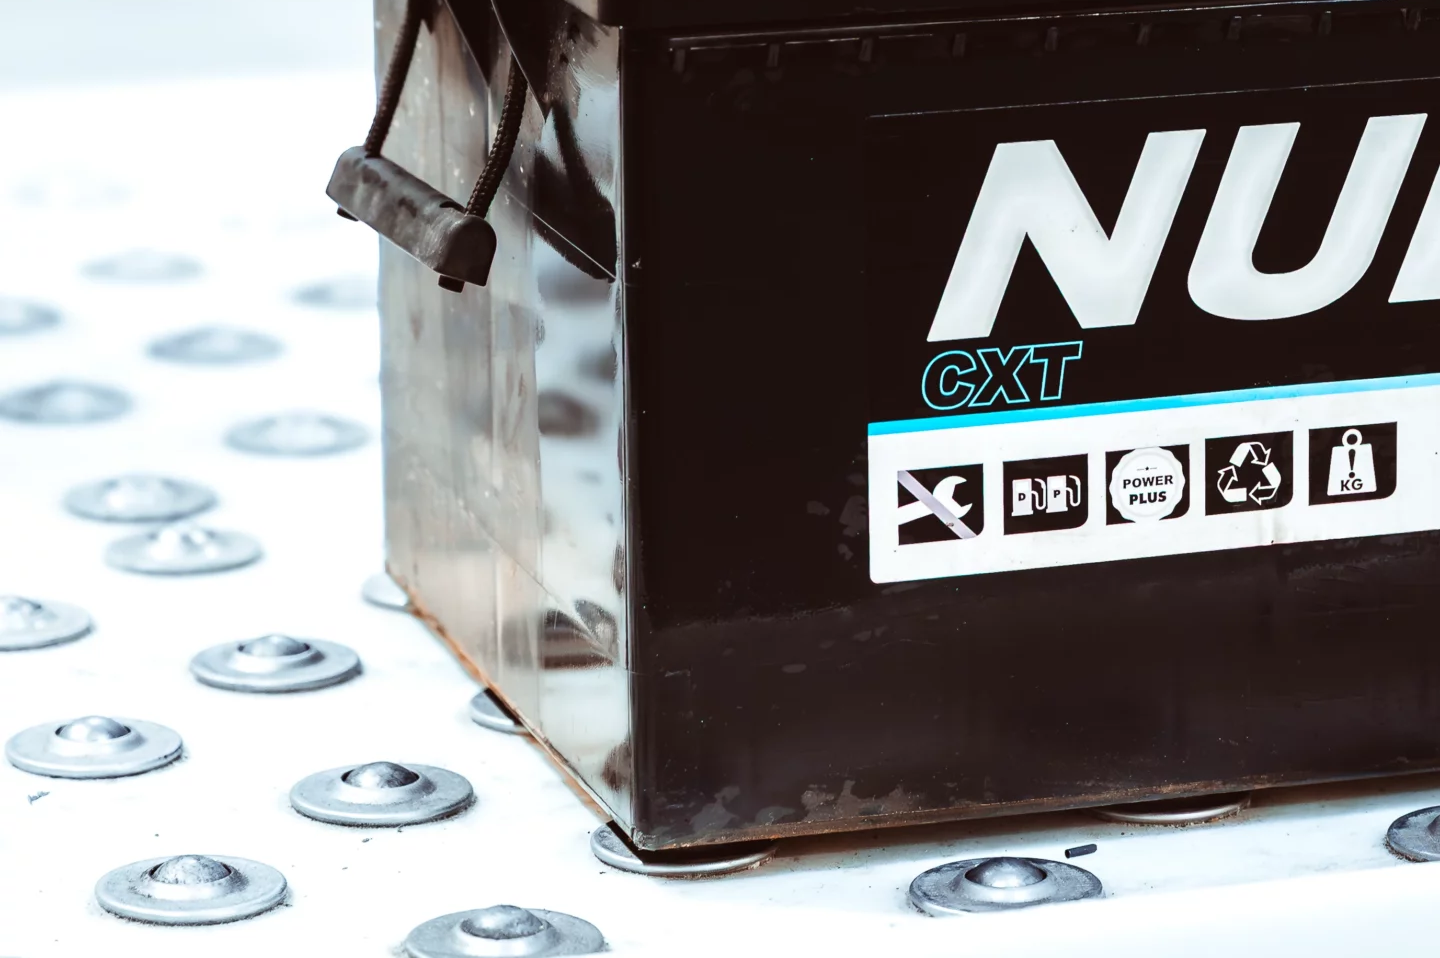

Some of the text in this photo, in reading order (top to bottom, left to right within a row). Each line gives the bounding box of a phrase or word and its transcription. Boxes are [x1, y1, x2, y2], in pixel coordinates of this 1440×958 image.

[921, 341, 1083, 410] CXT
[1122, 474, 1174, 490] POWER
[1340, 478, 1363, 492] KG
[1018, 489, 1061, 502] D P
[1129, 491, 1167, 506] PLUS
